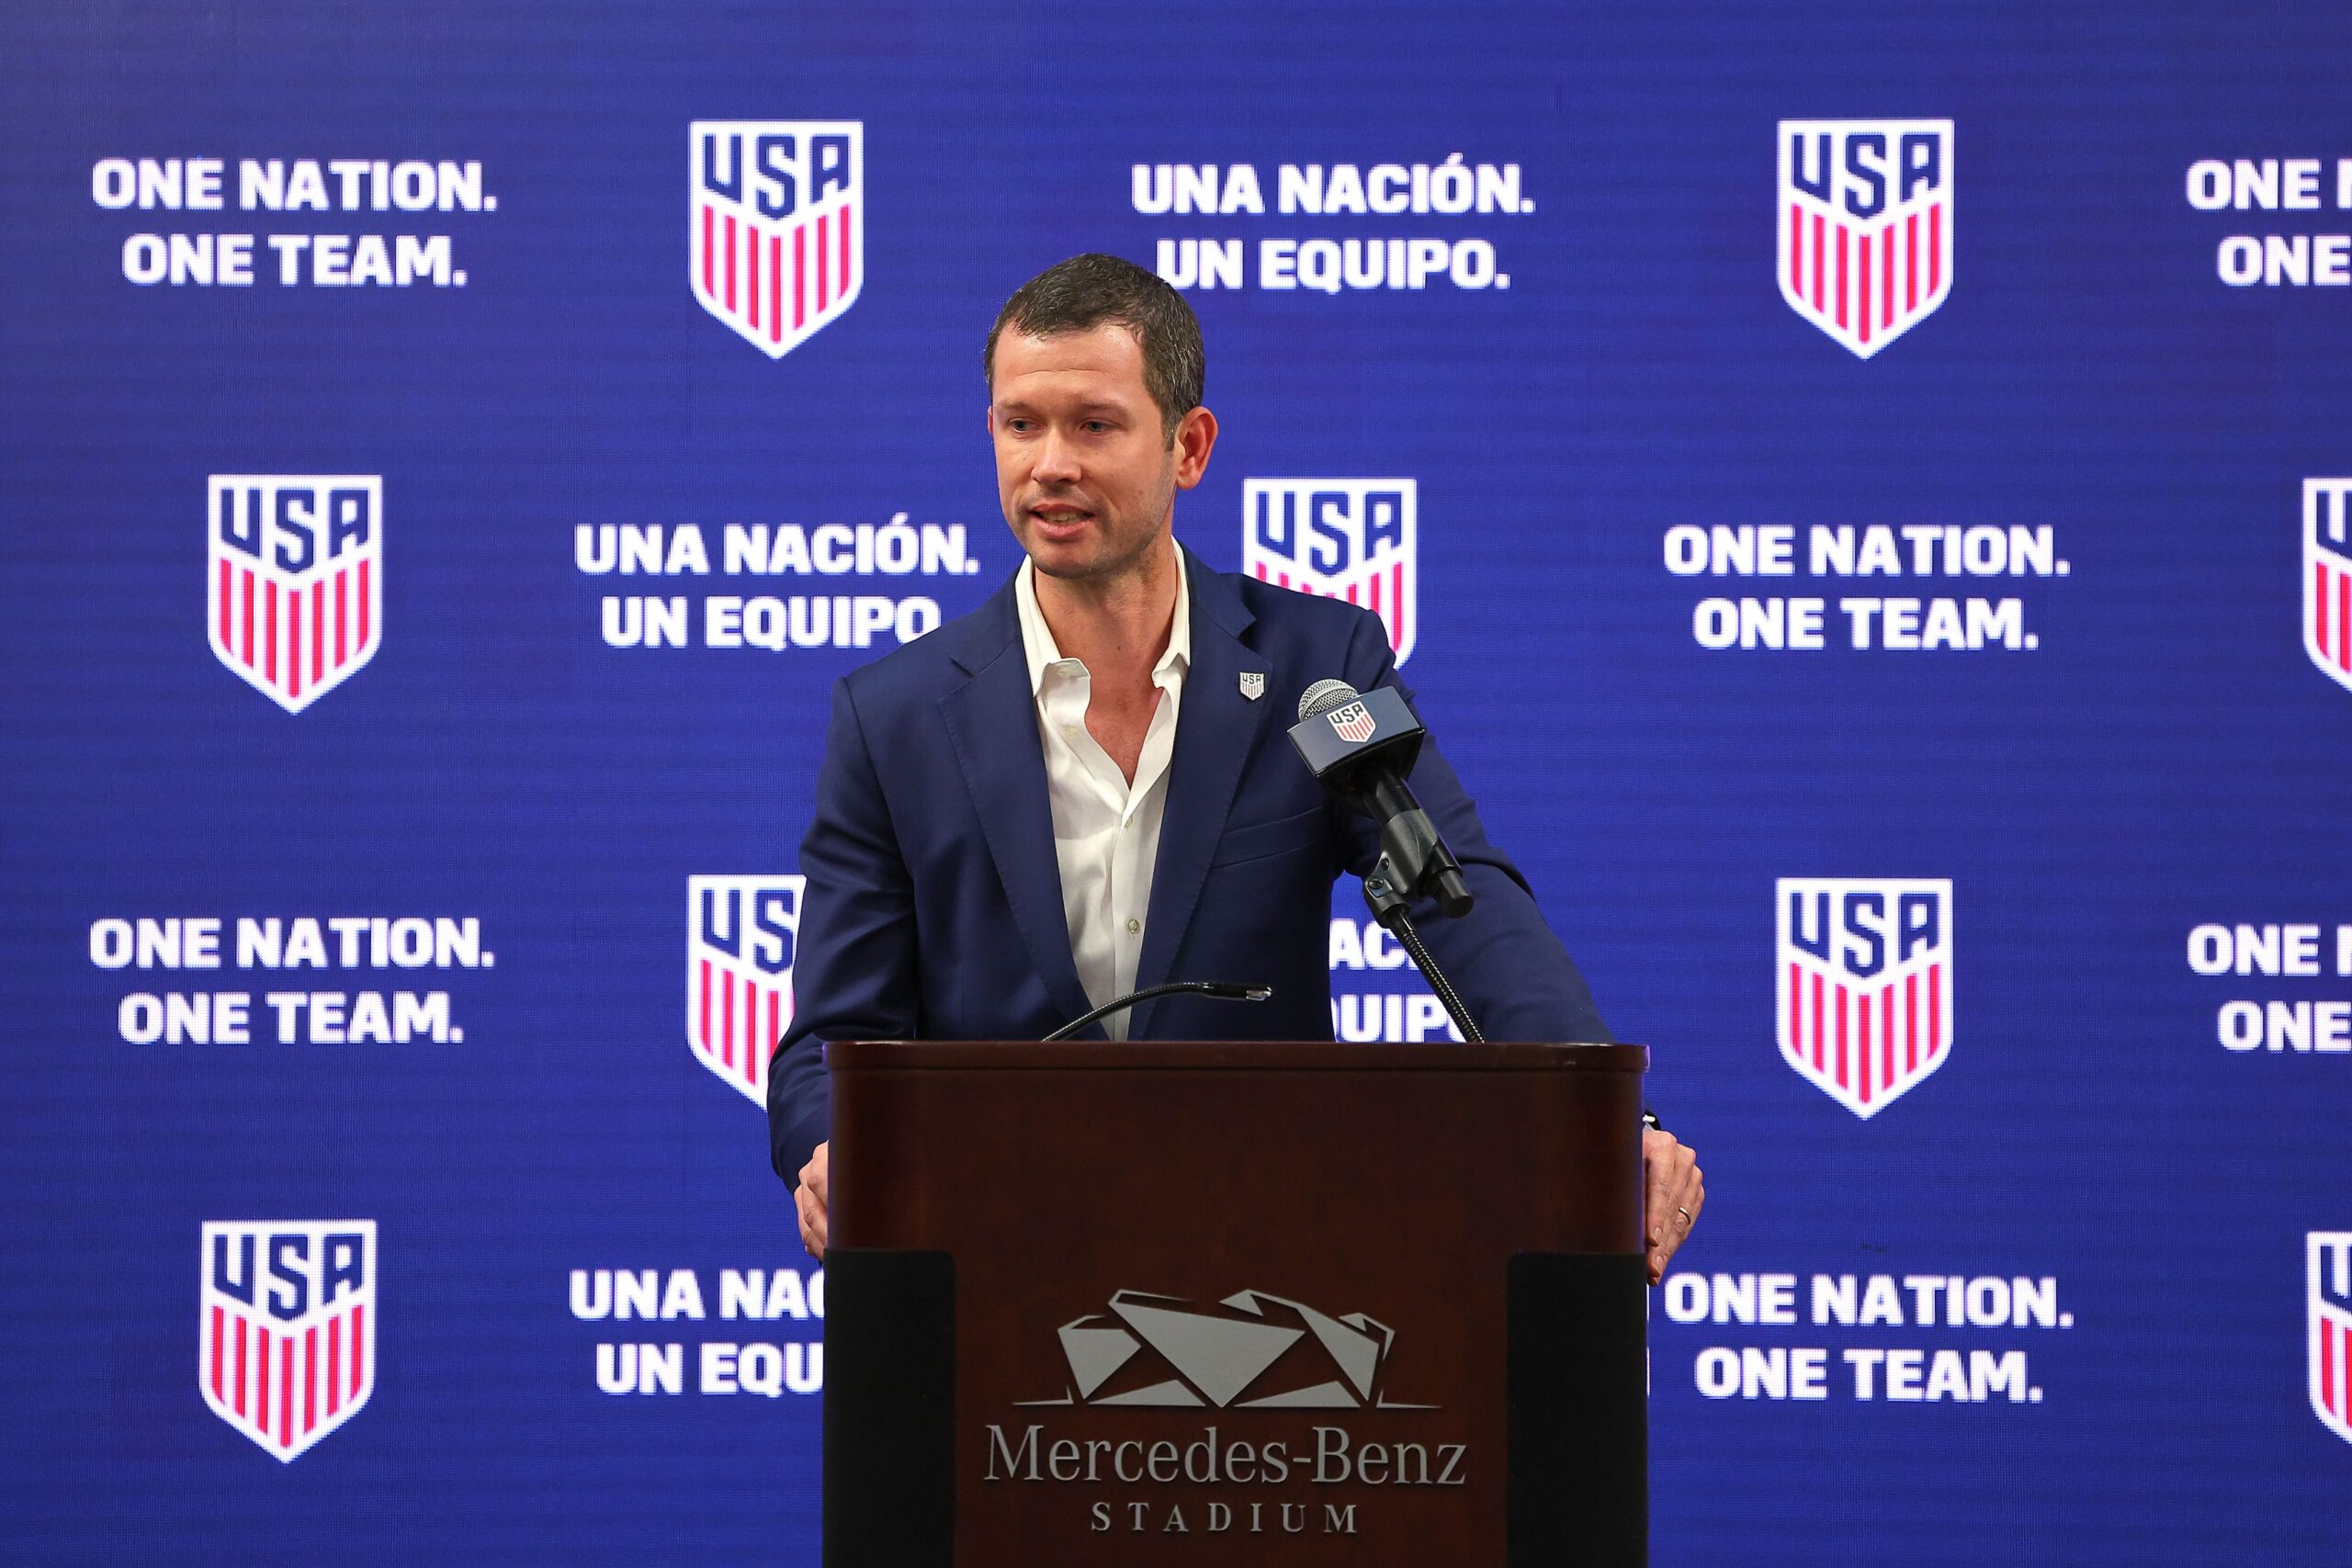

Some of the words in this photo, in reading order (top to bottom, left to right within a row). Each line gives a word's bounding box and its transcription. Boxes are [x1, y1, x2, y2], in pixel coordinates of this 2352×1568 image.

[92, 157, 224, 210] ONE
[239, 160, 497, 212] NATION.
[703, 133, 850, 220] USA
[1131, 164, 1265, 214] UNA
[1278, 152, 1536, 214] NACIÓN.
[1792, 132, 1940, 220] USA
[2187, 159, 2322, 210] ONE
[121, 232, 254, 287] ONE
[267, 234, 468, 288] TEAM.
[1156, 239, 1244, 290] UN
[1259, 239, 1511, 295] EQUIPO.
[2217, 235, 2352, 287] ONE
[220, 488, 369, 574] USA
[574, 523, 711, 576] UNA
[723, 512, 980, 576] NACIÓN.
[1256, 491, 1403, 578] USA
[1663, 524, 1796, 577] ONE
[1810, 525, 2071, 578] NATION.
[602, 596, 688, 649] UN
[1691, 597, 1825, 650] ONE
[1839, 597, 2039, 651] TEAM.
[1242, 674, 1261, 684] USA
[1329, 703, 1364, 724] USA
[89, 918, 221, 969] ONE
[236, 917, 494, 969] NATION.
[1329, 919, 1420, 971] AC
[1790, 890, 1939, 980] USA
[2187, 923, 2321, 976] ONE
[118, 991, 251, 1045] ONE
[265, 990, 464, 1045] TEAM.
[1331, 993, 1467, 1043] UIP
[2217, 1000, 2352, 1052] ONE
[213, 1234, 364, 1323] USA
[569, 1269, 706, 1321] UNA
[1664, 1272, 1798, 1325] ONE
[1811, 1274, 2075, 1328] NATION.
[596, 1343, 684, 1395] UN
[1694, 1347, 1827, 1401] ONE
[1843, 1348, 2043, 1404] TEAM.
[983, 1425, 1467, 1484] Mercedes-Benz
[1091, 1502, 1358, 1534] STADIUM
